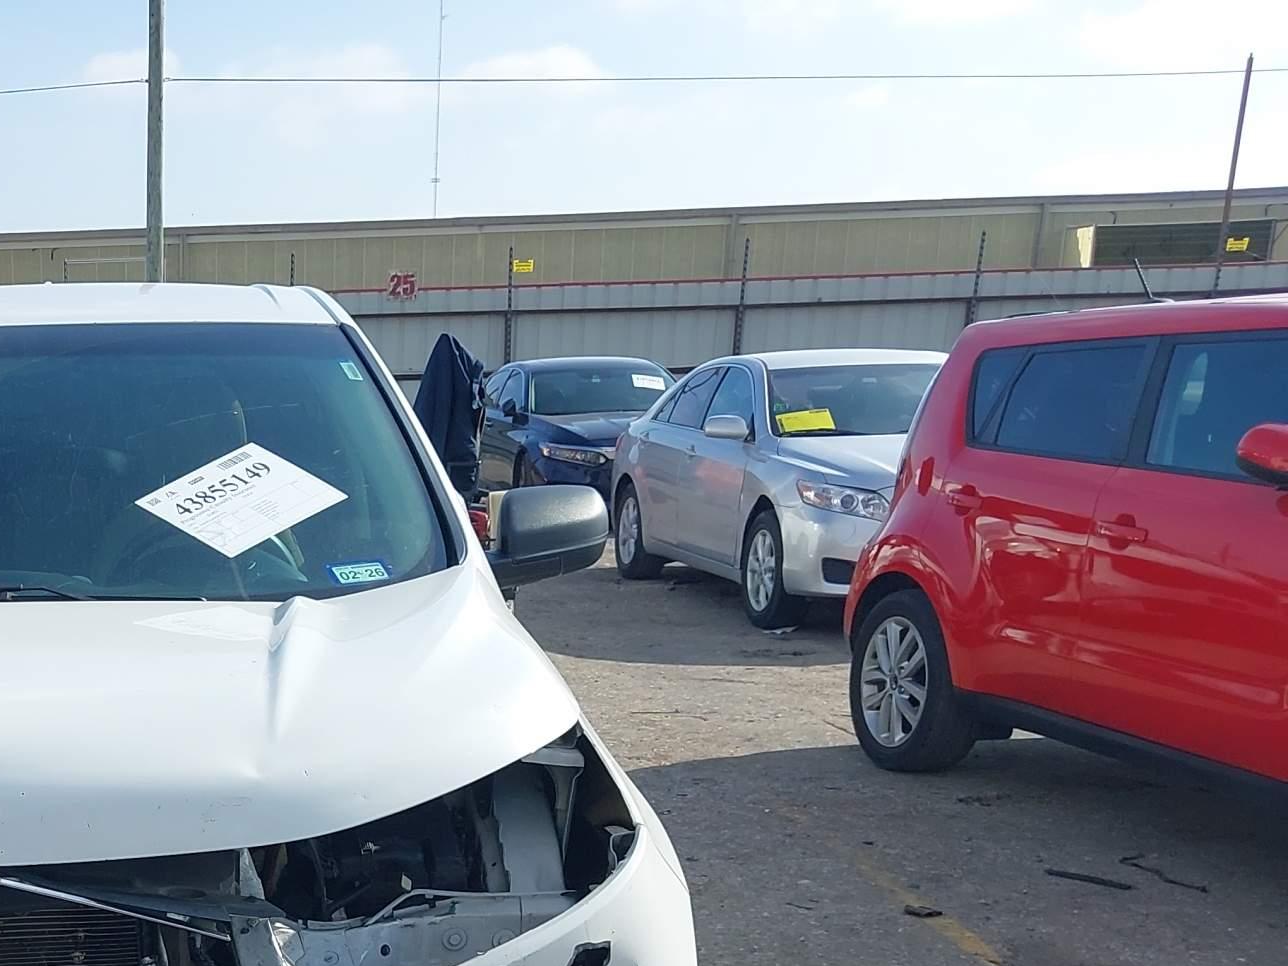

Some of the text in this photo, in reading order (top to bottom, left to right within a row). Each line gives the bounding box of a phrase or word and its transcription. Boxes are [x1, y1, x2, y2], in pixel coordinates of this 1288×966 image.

[389, 273, 416, 297] 25
[175, 461, 272, 516] 43855149
[339, 567, 385, 581] 02 26
